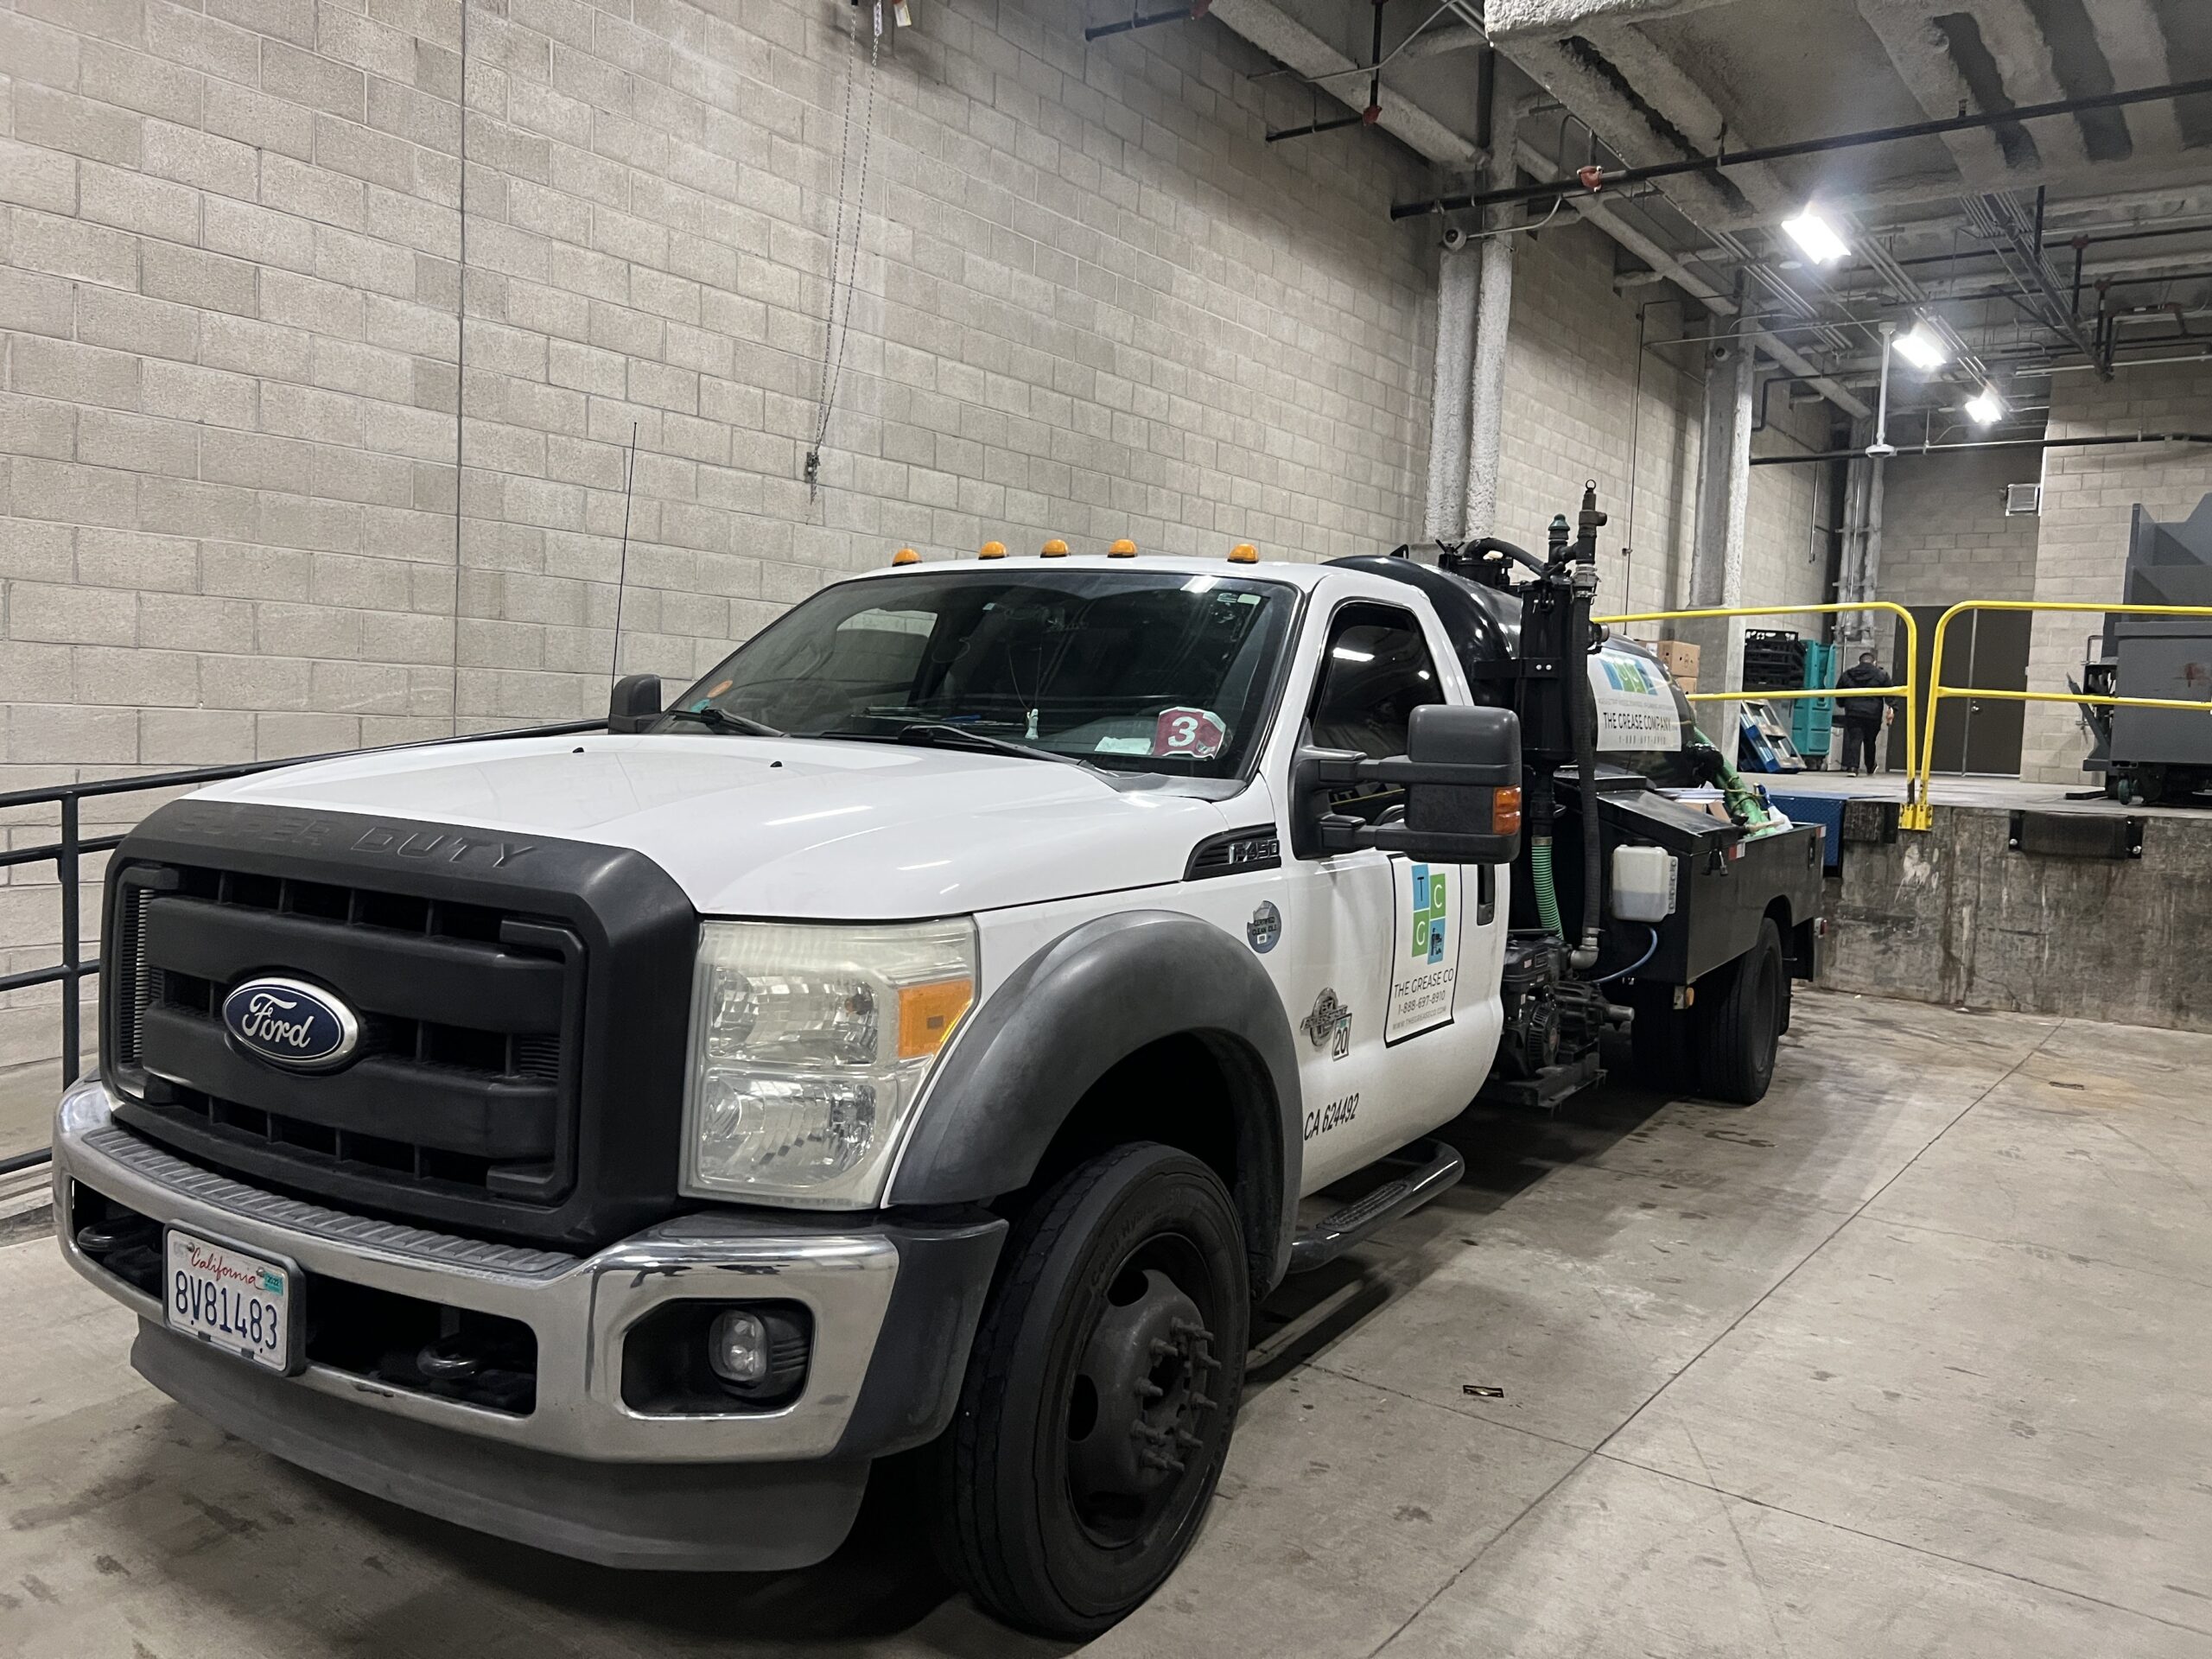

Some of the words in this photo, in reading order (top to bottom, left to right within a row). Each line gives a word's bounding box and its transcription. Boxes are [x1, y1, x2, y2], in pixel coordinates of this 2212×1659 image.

[1167, 715, 1198, 747] 3
[1603, 712, 1617, 729] THE
[1618, 713, 1643, 730] GREASE
[1643, 715, 1672, 732] COMPANY
[349, 825, 539, 868] DUTY
[1416, 875, 1425, 902] T
[1433, 883, 1443, 909] C
[1416, 920, 1426, 946] G
[1394, 981, 1410, 999] THE
[1411, 970, 1442, 993] GREASE
[1443, 968, 1454, 983] CO
[1398, 989, 1446, 1015] 1-888-697-8910
[241, 992, 315, 1049] Ford
[1333, 1027, 1348, 1056] 20
[1304, 1110, 1320, 1141] CA
[1322, 1092, 1359, 1133] 624492
[190, 1247, 266, 1290] California
[175, 1270, 277, 1350] 8V81483
